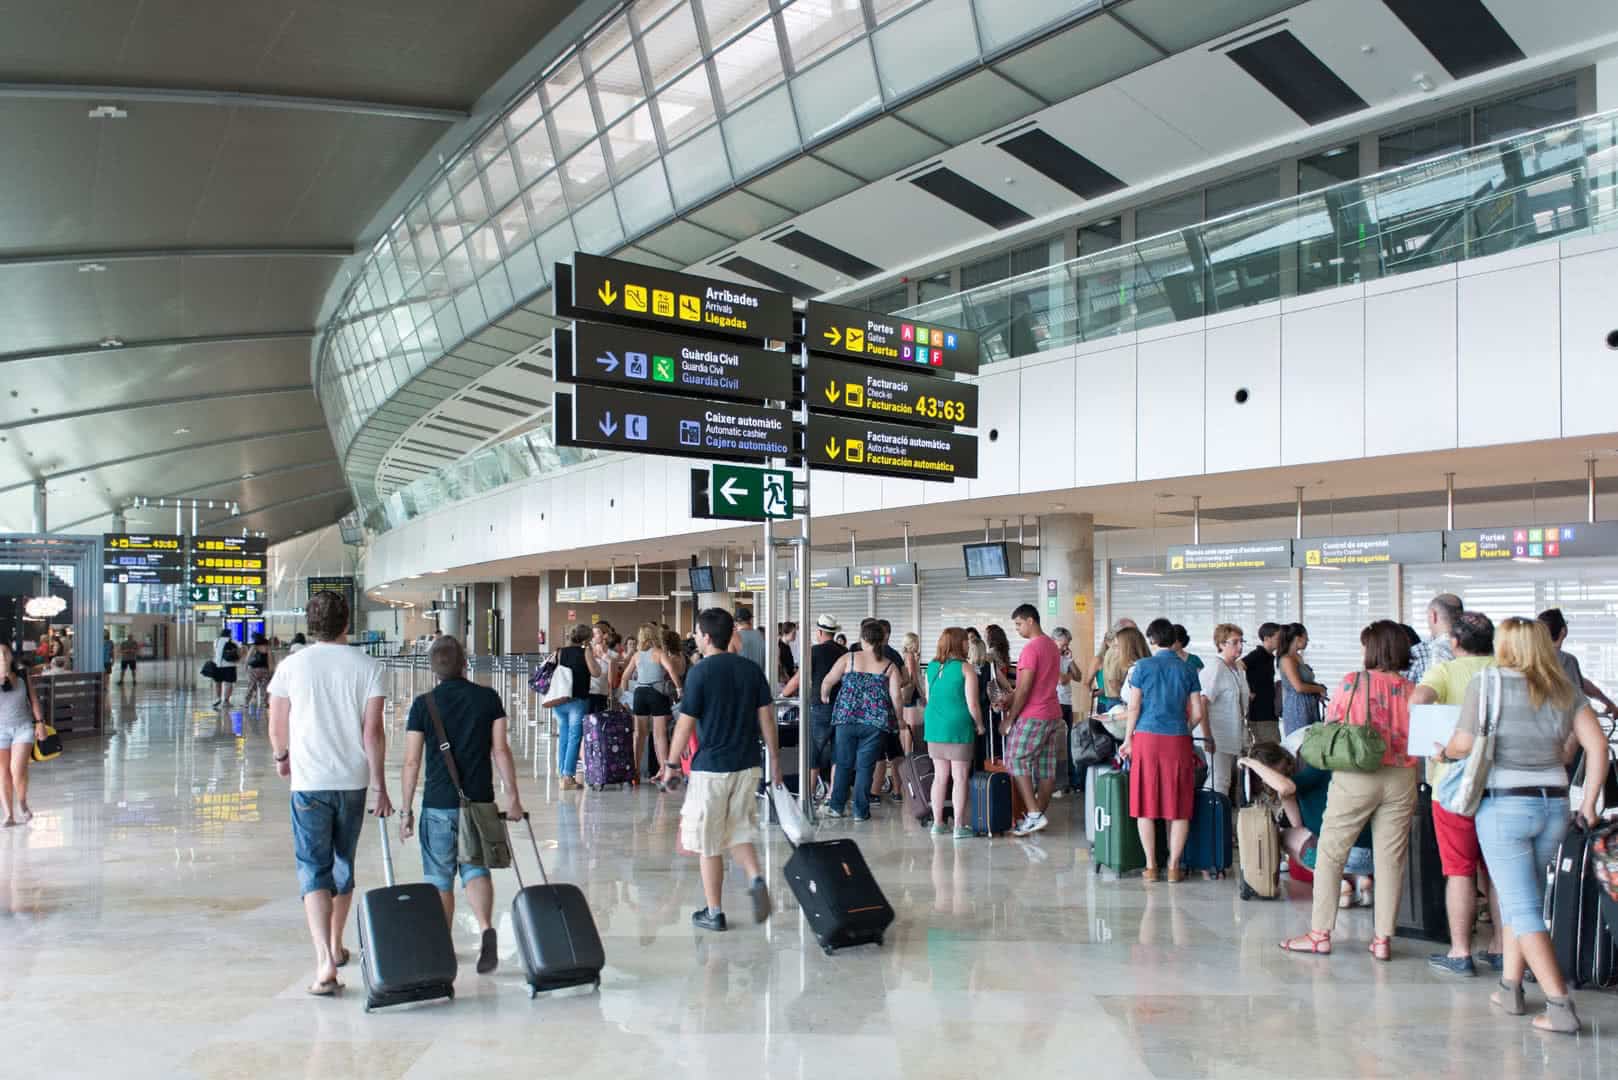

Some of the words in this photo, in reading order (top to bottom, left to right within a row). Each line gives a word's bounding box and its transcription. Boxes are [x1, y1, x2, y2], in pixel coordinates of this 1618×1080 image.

[706, 287, 759, 307] Arribades
[705, 301, 733, 314] Arrivals
[705, 312, 747, 329] Llegadas
[867, 320, 894, 335] Portes
[681, 348, 719, 363] Guàrdia
[719, 353, 739, 366] Civil
[867, 343, 898, 358] Puertas
[681, 372, 719, 387] Guardia
[720, 377, 739, 389] Civil
[867, 376, 909, 392] Facturació
[866, 398, 913, 415] Facturación
[705, 411, 737, 425] Caixer
[737, 416, 783, 430] automàtic
[705, 423, 742, 437] Automatic
[742, 428, 768, 440] cashier
[867, 431, 909, 446] Facturació
[705, 435, 738, 449] Cajero
[738, 440, 788, 453] automático
[867, 442, 882, 453] Auto
[866, 452, 913, 467] Facturación
